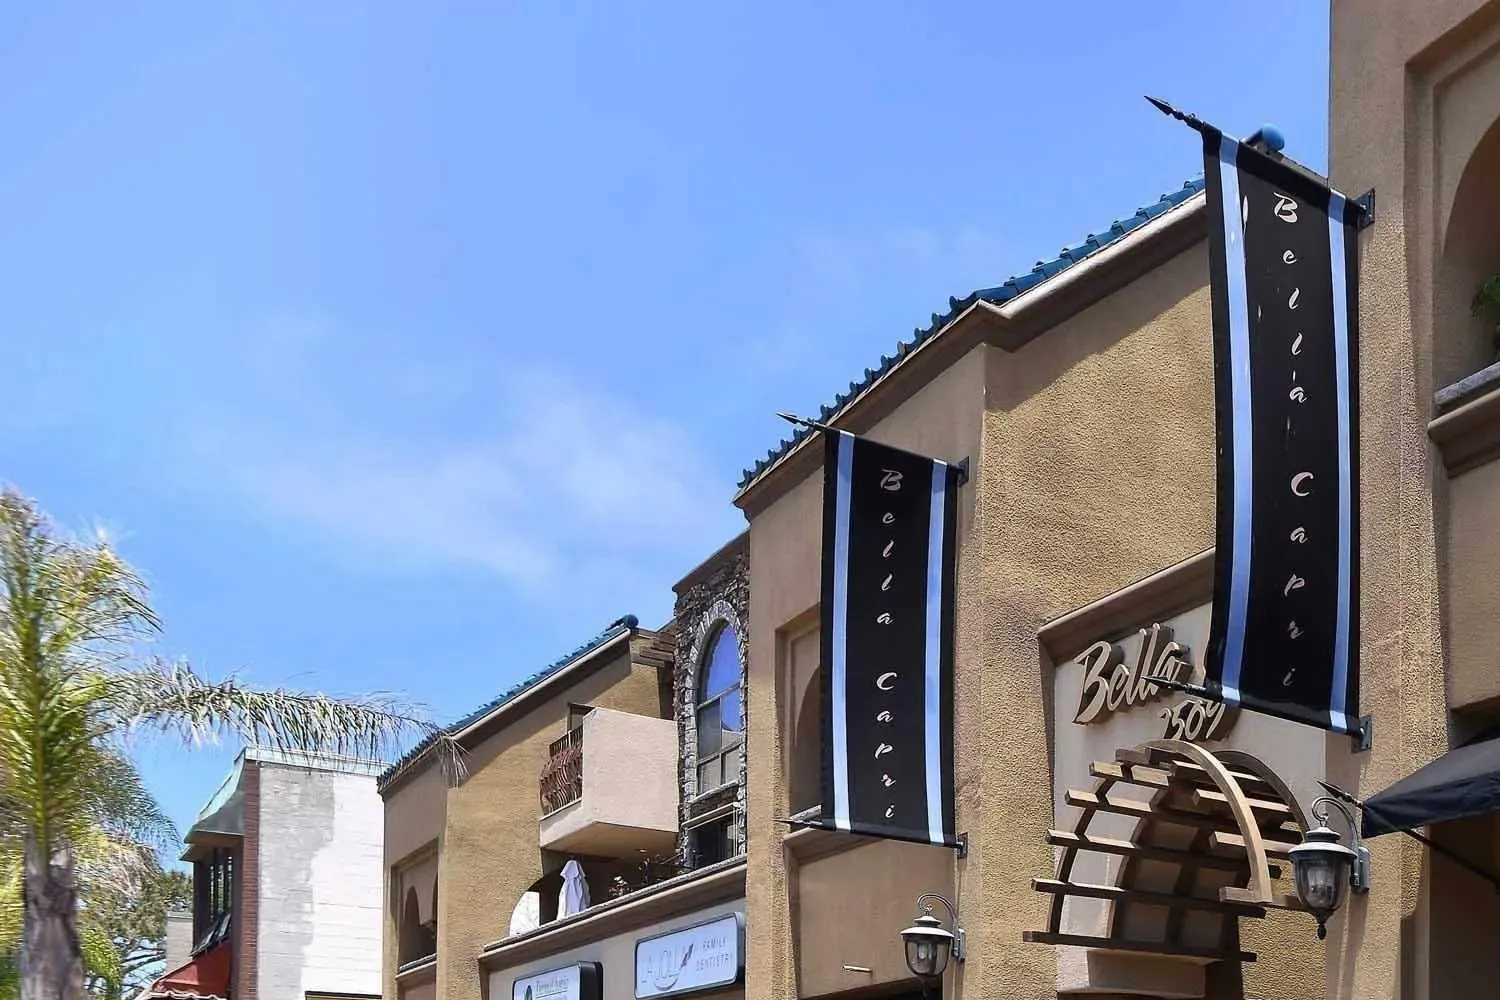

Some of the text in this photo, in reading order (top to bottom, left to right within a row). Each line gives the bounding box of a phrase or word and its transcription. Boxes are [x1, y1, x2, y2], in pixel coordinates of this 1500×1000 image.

[1272, 191, 1315, 688] Bella Capri
[874, 468, 904, 820] Bella Capri
[1072, 622, 1191, 726] Bella
